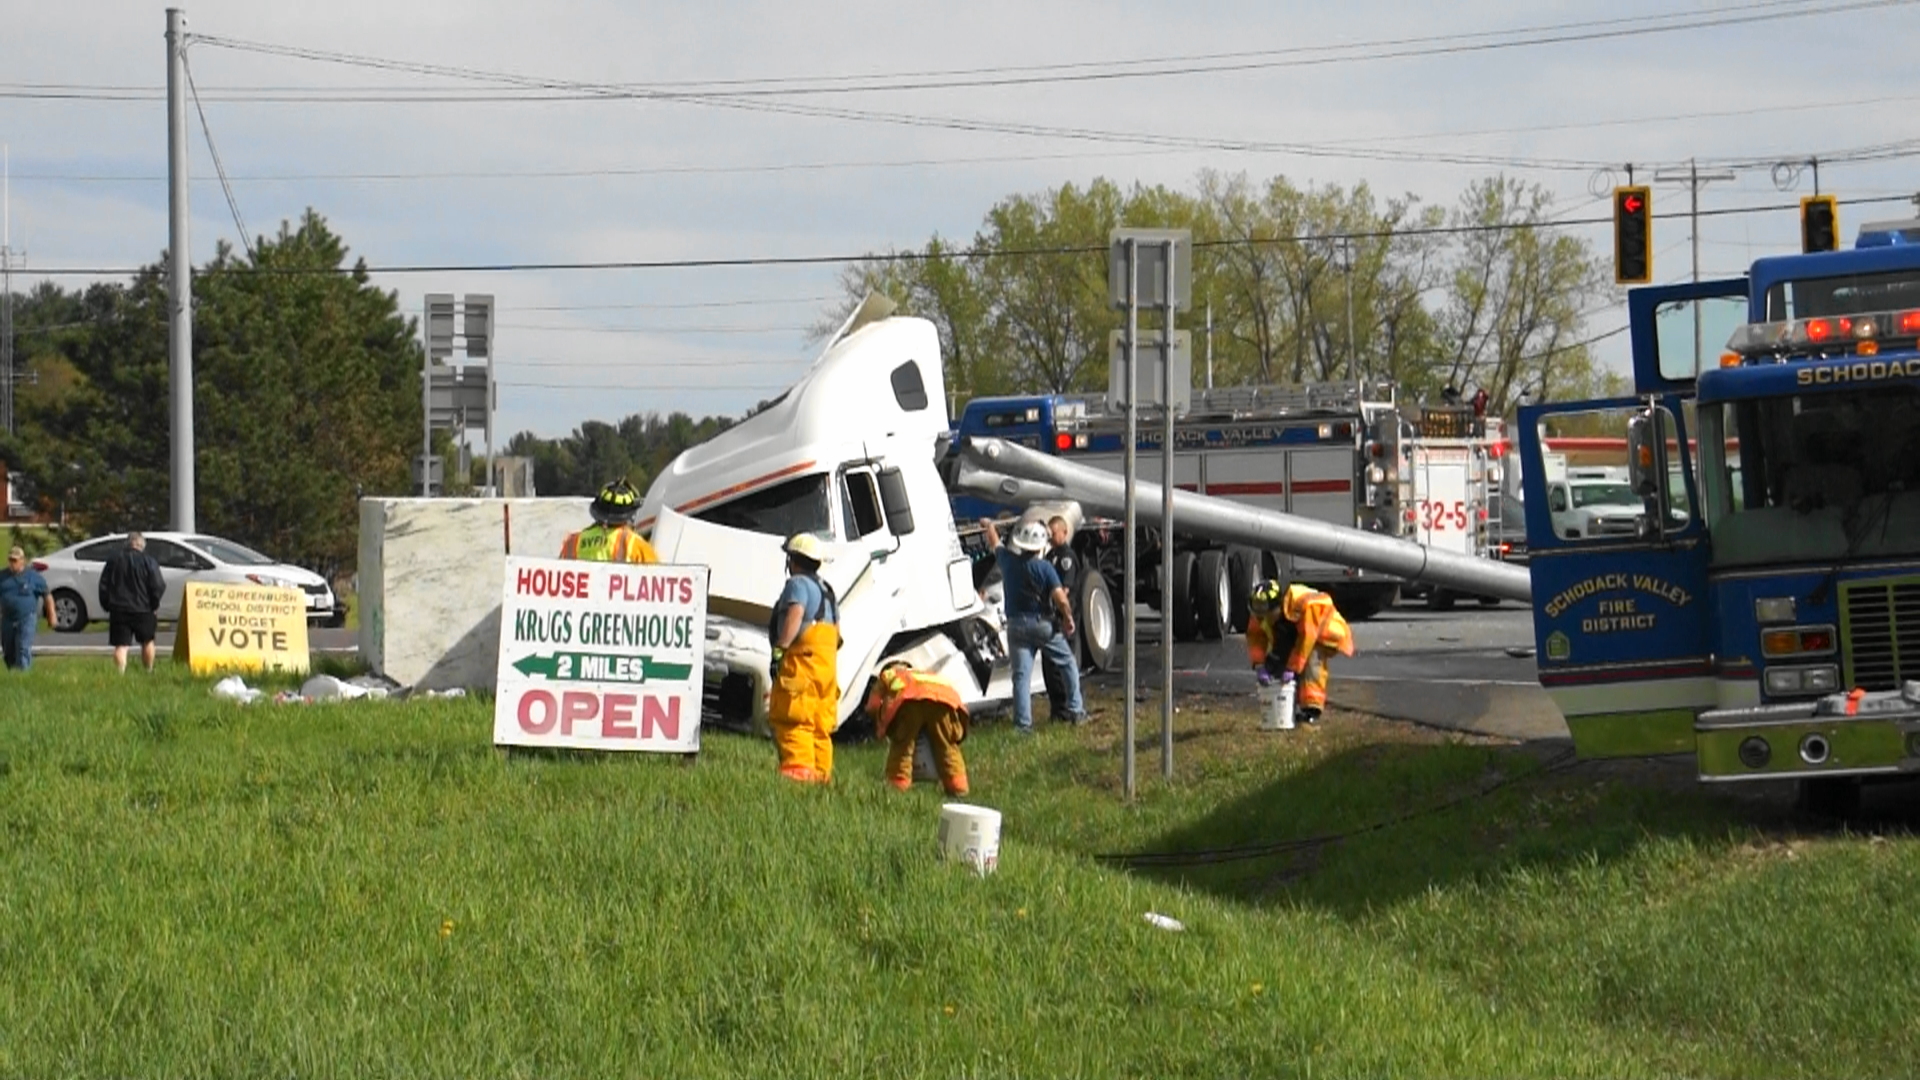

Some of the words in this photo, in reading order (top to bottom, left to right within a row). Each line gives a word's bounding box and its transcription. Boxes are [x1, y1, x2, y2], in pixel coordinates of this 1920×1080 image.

[1120, 430, 1207, 443] HOACK
[1221, 427, 1286, 440] VALLEY
[1421, 501, 1467, 530] 32-5
[195, 588, 225, 598] EAST
[227, 589, 298, 602] GREENBUSH
[516, 567, 589, 598] HOUSE
[608, 574, 693, 604] PLANTS
[1545, 573, 1628, 618] SCHODACK
[1632, 573, 1692, 607] VALLEY
[196, 600, 241, 613] SCHOOL
[246, 604, 298, 615] DISTRICT
[1598, 598, 1636, 615] FIRE
[218, 615, 277, 628] BUDGET
[514, 608, 572, 644] KRUGS
[579, 611, 694, 649] GREENHOUSE
[1582, 614, 1656, 633] DISTRICT
[208, 628, 288, 651] VOTE
[556, 655, 573, 677] 2
[580, 656, 644, 681] MILES
[516, 689, 681, 740] OPEN
